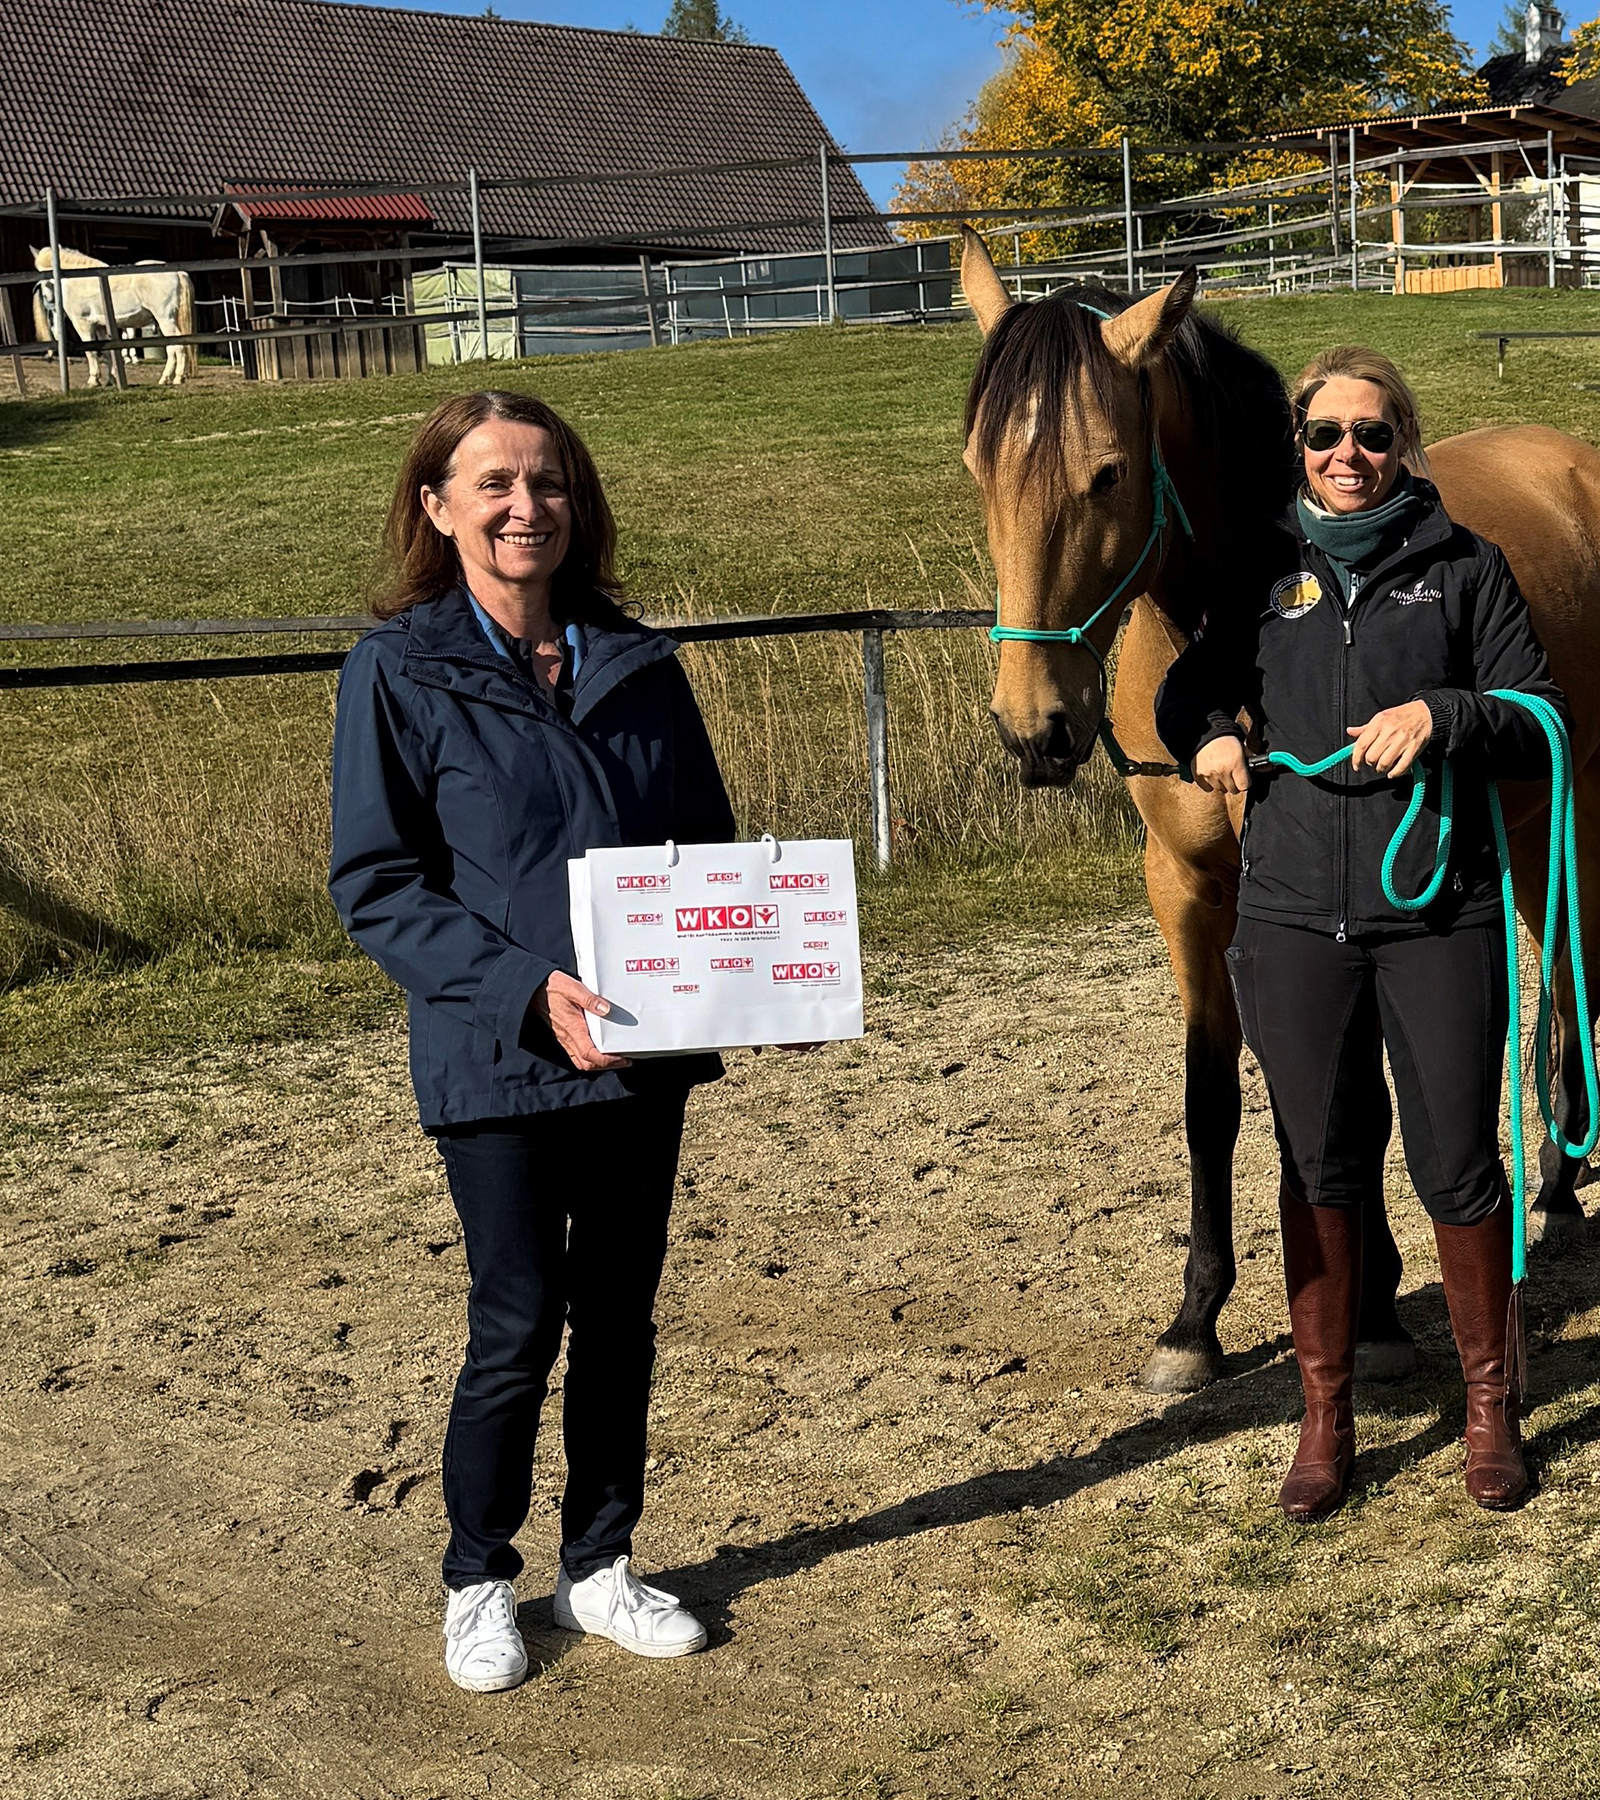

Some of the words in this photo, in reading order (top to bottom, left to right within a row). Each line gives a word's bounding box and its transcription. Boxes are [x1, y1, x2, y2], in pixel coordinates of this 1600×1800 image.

[617, 876, 656, 888] WKO
[770, 874, 813, 889] WKO
[676, 906, 752, 930] WKO
[804, 911, 836, 922] WKO
[626, 958, 665, 971] WKO
[710, 958, 743, 969] WKO
[772, 963, 823, 980] WKO
